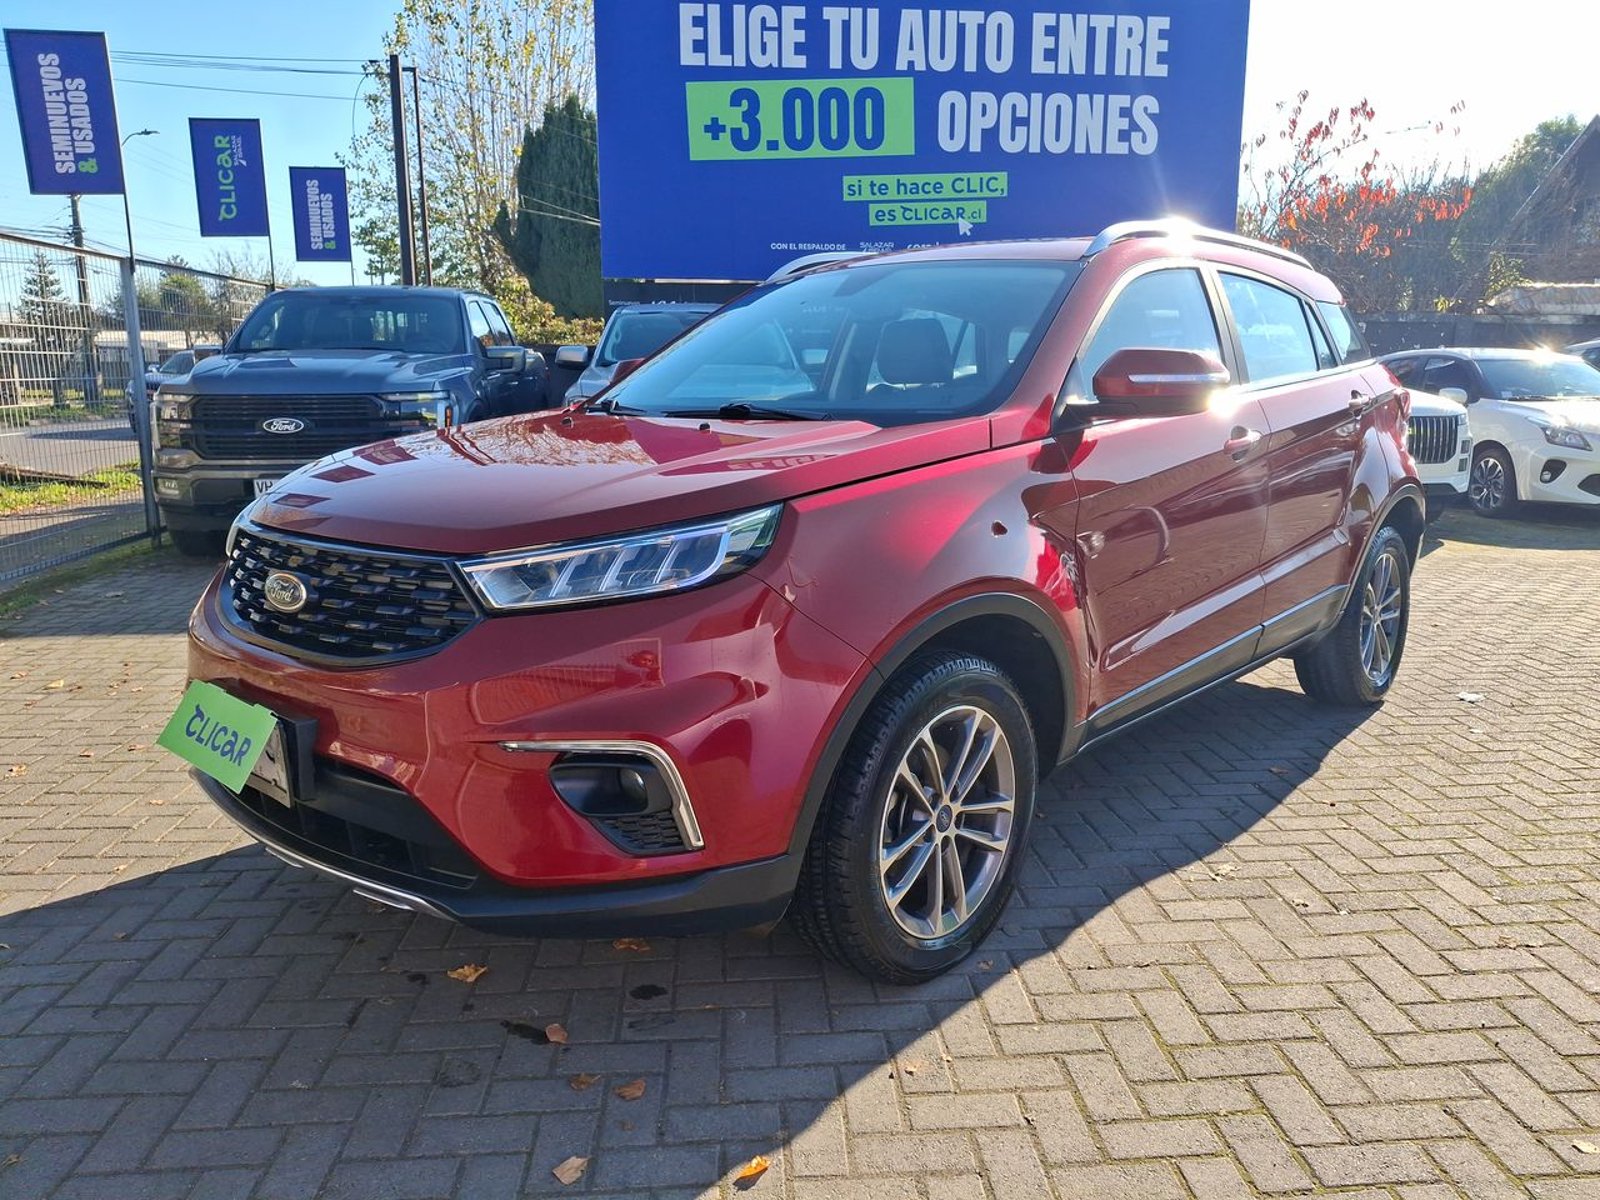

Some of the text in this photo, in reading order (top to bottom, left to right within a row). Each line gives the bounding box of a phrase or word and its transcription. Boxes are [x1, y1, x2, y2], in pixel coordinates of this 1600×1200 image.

[680, 3, 1171, 77] ELIGE TU AUTO ENTRE
[38, 53, 76, 174] SEMINUEVOS
[65, 78, 98, 174] & USADOS
[704, 86, 1160, 156] +3.000 OPCIONES
[306, 180, 323, 250] SEMINUEVOS
[847, 177, 1005, 196] si te hace CLIC,
[875, 208, 896, 222] es
[320, 193, 336, 250] & USADOS
[770, 242, 788, 250] CON
[798, 243, 836, 251] RESPALDO
[836, 243, 846, 251] DE
[271, 420, 296, 431] Ford
[268, 579, 294, 602] Ford
